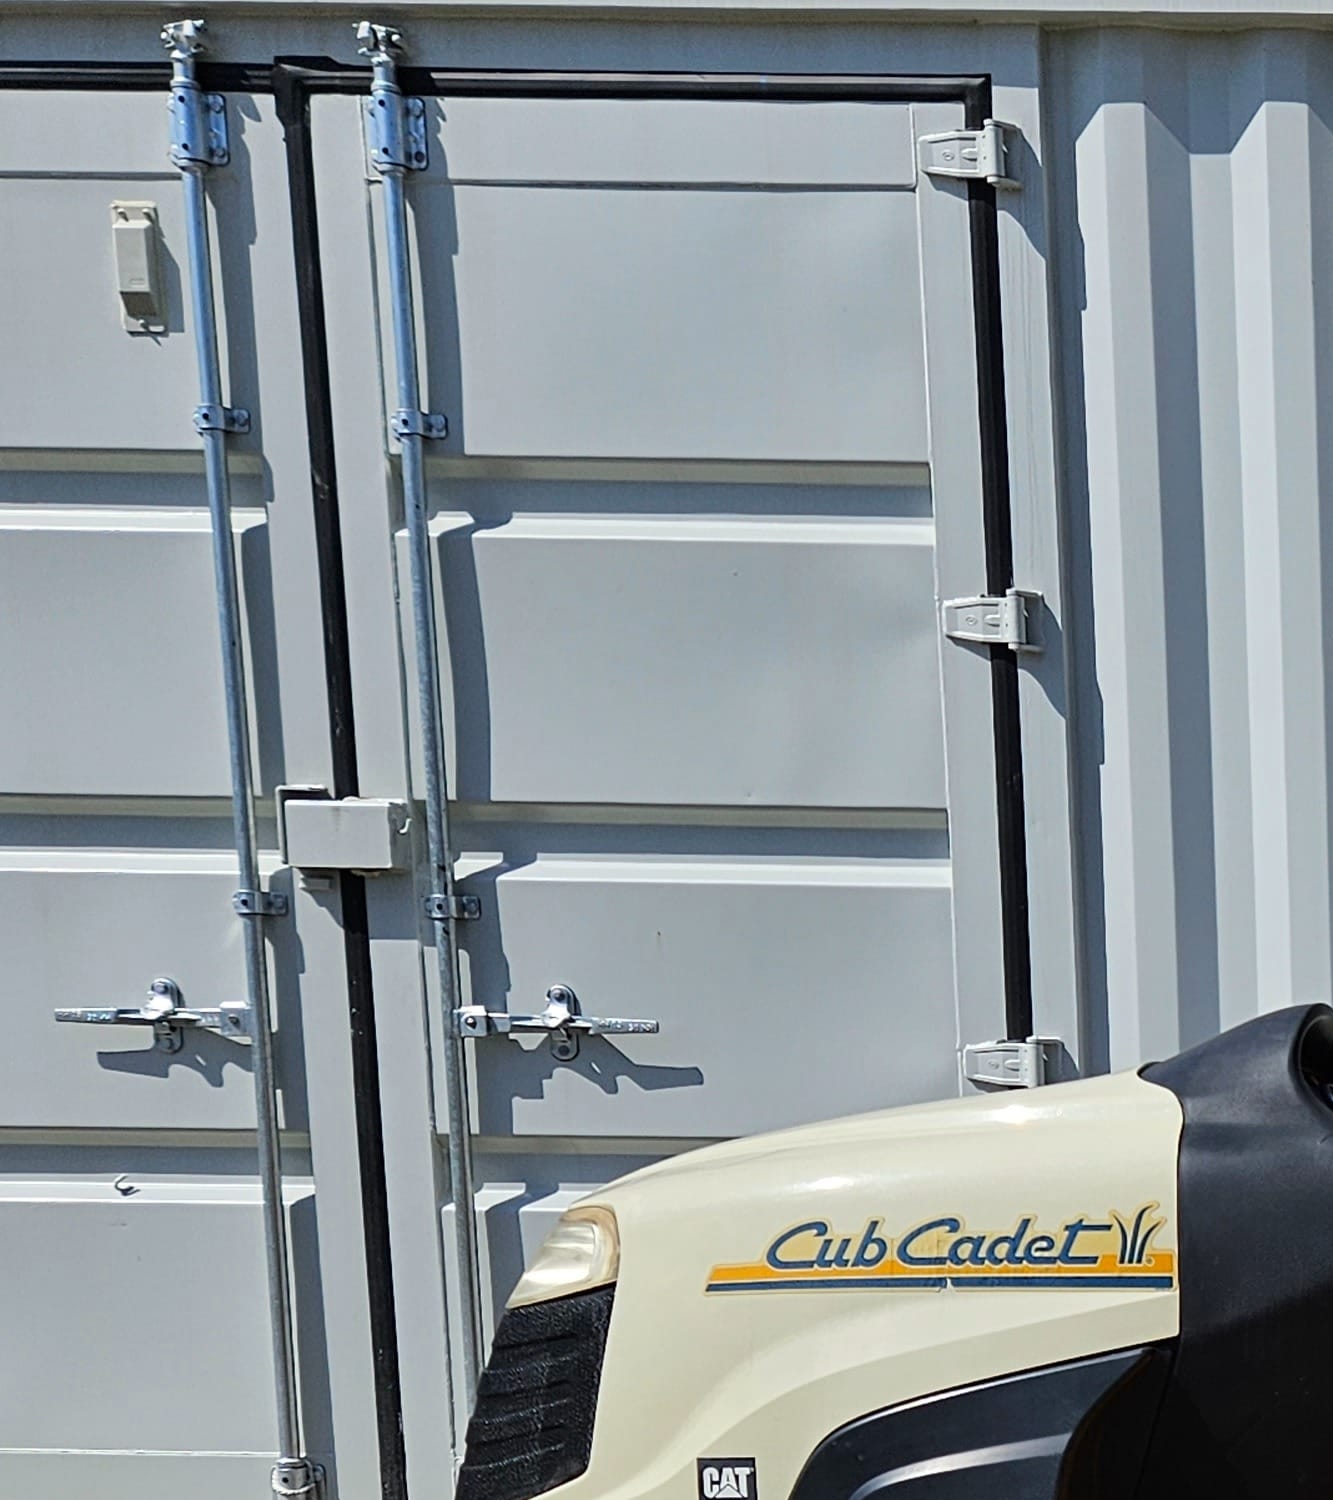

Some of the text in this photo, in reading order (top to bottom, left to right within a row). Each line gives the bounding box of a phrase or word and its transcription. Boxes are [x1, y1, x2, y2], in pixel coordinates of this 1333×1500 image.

[765, 1217, 1113, 1268] Cub Cadet
[703, 1467, 751, 1498] CAT
